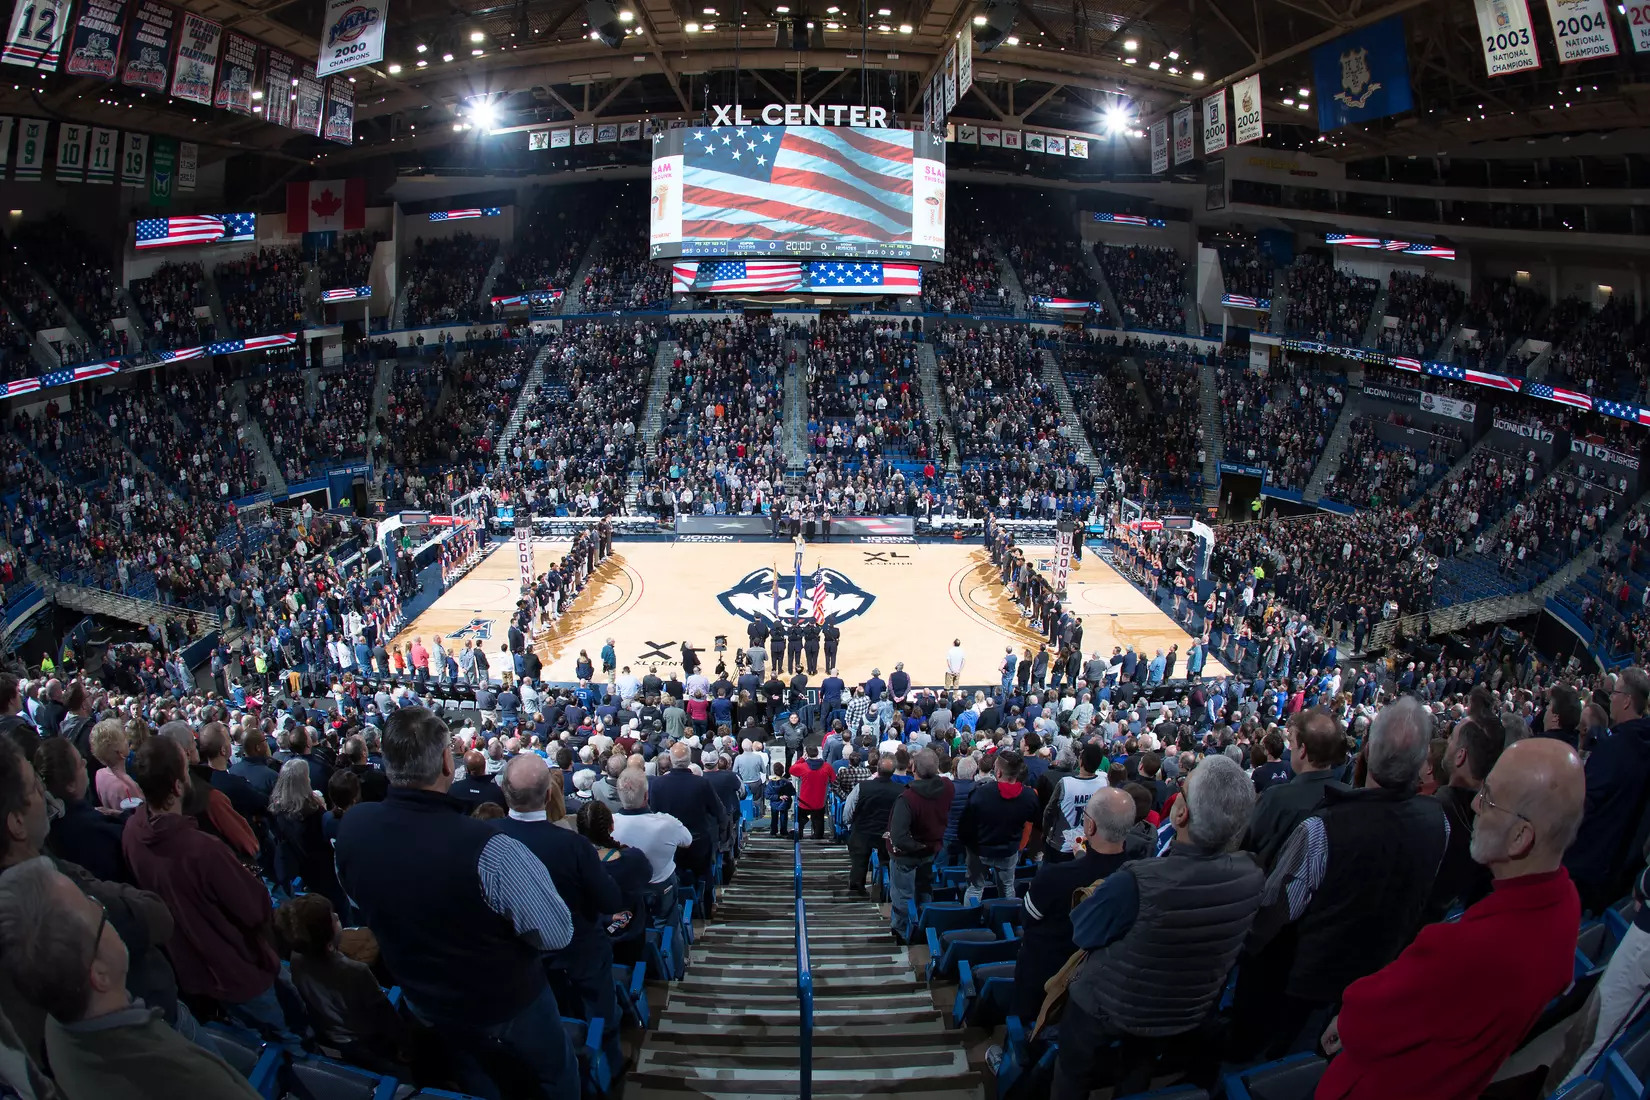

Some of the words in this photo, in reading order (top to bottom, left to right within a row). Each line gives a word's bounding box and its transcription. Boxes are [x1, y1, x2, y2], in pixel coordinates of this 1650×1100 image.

[87, 7, 118, 23] SEASON
[19, 4, 57, 43] 12
[79, 16, 122, 36] CHAMPIONS
[328, 8, 379, 48] MAAC
[1556, 12, 1606, 38] 2004
[136, 32, 168, 48] CHAMPIONS
[193, 40, 206, 50] CUP
[1486, 28, 1530, 52] 2003
[1566, 34, 1604, 48] NATIONAL
[180, 46, 216, 66] CHAMPIONS
[335, 42, 366, 58] 2000
[1492, 48, 1528, 62] NATIONAL
[1564, 44, 1610, 59] CHAMPIONS
[225, 54, 256, 71] CHAMPIONS
[330, 52, 370, 68] CHAMPIONS
[1492, 58, 1534, 72] CHAMPIONS
[712, 104, 752, 126] XL
[761, 104, 887, 128] CENTER
[1237, 110, 1260, 128] 2002
[655, 132, 664, 144] XL
[1205, 123, 1226, 140] 2000
[1238, 132, 1260, 142] CHAMPIONS
[932, 135, 942, 146] XL
[1176, 136, 1192, 152] 1999
[1206, 143, 1226, 153] CHAMPIONS
[24, 140, 36, 164] 9
[61, 143, 80, 165] 10
[94, 147, 110, 168] 11
[125, 152, 143, 174] 19
[786, 241, 811, 250] 20:00
[932, 248, 941, 259] XL
[1362, 386, 1390, 398] UCONN
[1493, 418, 1520, 434] UCONN
[1608, 452, 1640, 470] HUSKIES
[518, 531, 530, 584] UCONN
[864, 552, 910, 562] XL
[1058, 536, 1070, 589] UCONN
